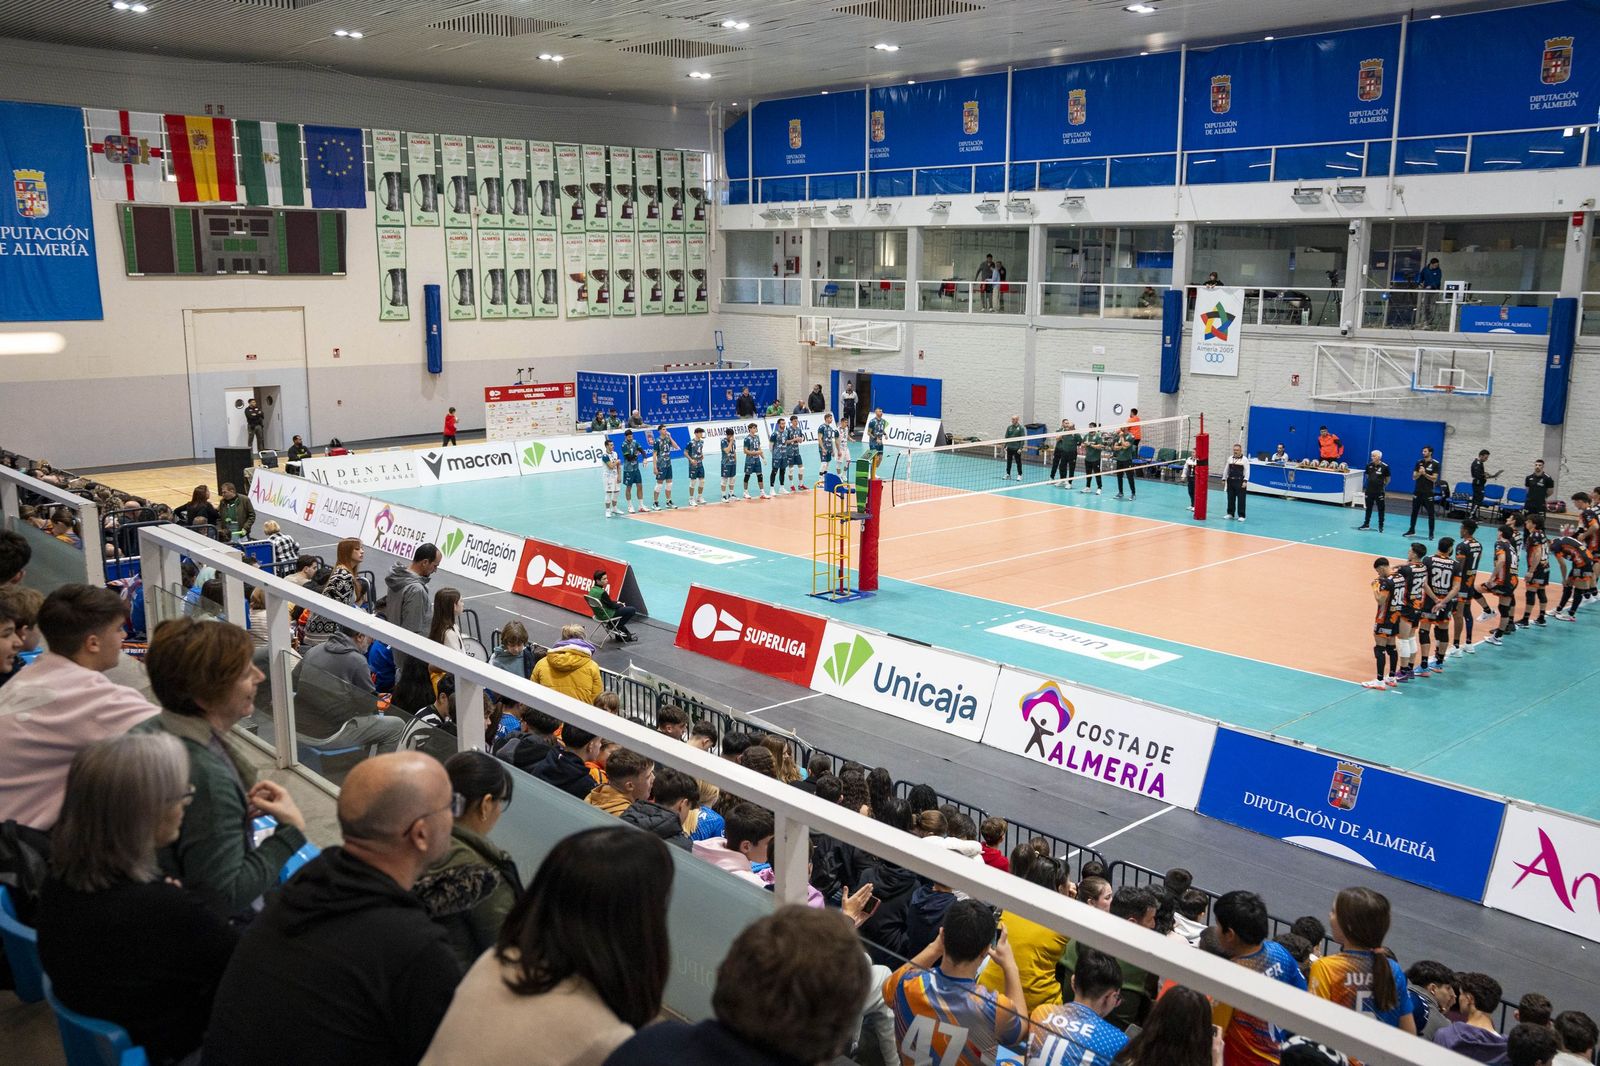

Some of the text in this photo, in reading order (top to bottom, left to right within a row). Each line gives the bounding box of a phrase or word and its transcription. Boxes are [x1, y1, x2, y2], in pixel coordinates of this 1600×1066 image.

[1530, 91, 1579, 102] DIPUTACIÓN
[1542, 99, 1576, 109] ALMERÍA
[12, 241, 89, 256] ALMERÍA
[889, 427, 932, 446] Unicaja
[447, 452, 512, 471] macron
[551, 447, 603, 464] Unicaja
[337, 462, 413, 477] DENTAL
[339, 476, 379, 485] IGNACIO
[322, 497, 361, 520] ALMERÍA
[319, 514, 338, 527] CIUDAD
[392, 524, 426, 543] COSTA DE
[381, 540, 418, 560] ALMERÍ
[465, 533, 516, 562] Fundación
[461, 550, 496, 576] Unicaja
[1432, 568, 1452, 588] 20
[1391, 588, 1405, 605] 30
[744, 627, 806, 659] SUPERLIGA
[1015, 624, 1108, 650] Unicaja
[873, 662, 978, 723] Unicaja
[1076, 720, 1174, 765] COSTA DE
[1048, 741, 1166, 799] ALMERÍA
[1243, 792, 1435, 863] DIPUTACIÓN DE ALMERÍA
[1041, 1013, 1095, 1039] JOSE
[902, 1014, 969, 1066] 47
